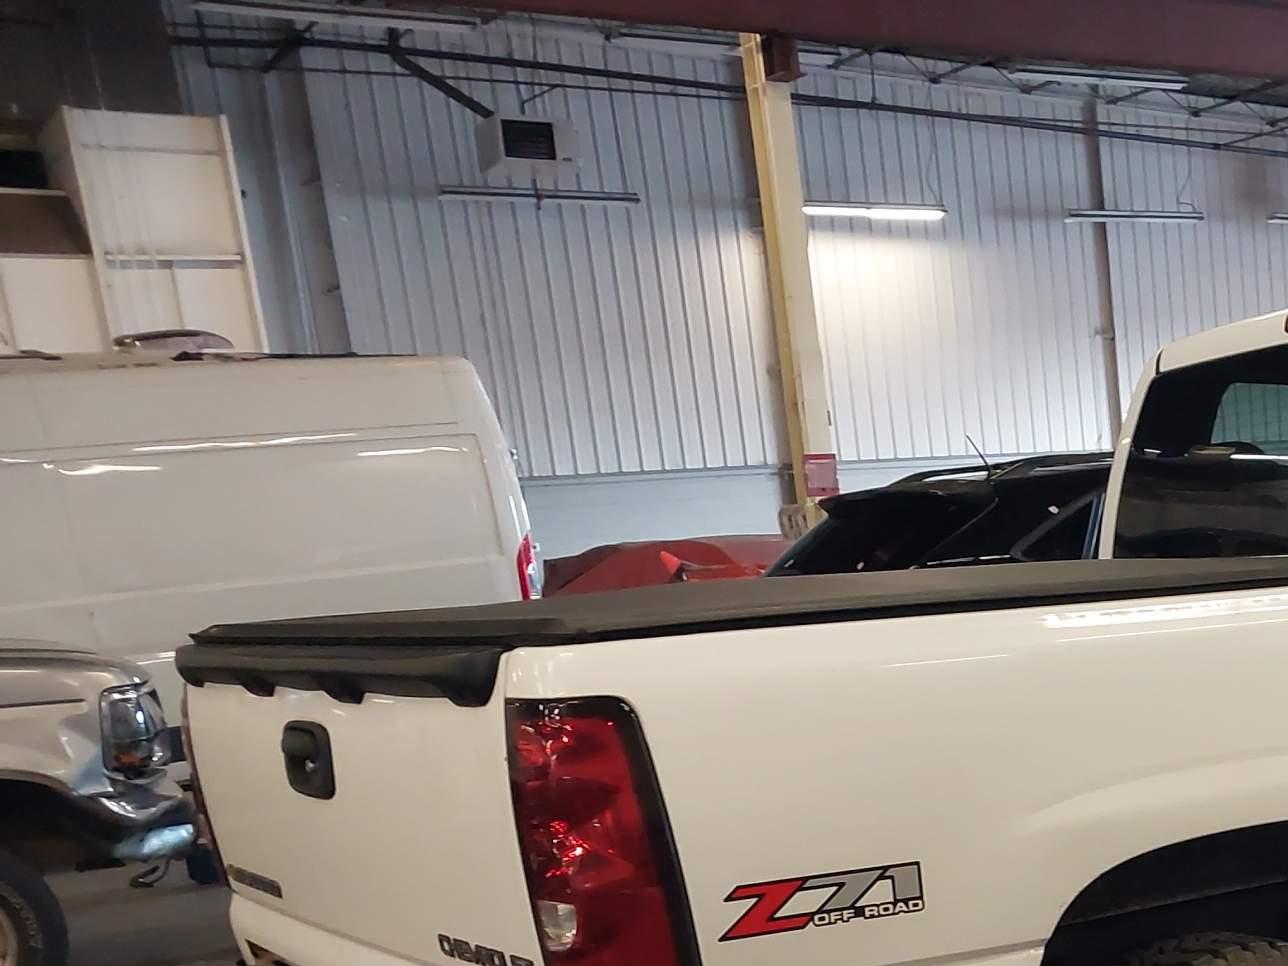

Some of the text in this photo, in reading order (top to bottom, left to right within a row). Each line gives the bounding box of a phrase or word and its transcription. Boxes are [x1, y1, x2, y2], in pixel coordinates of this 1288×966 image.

[718, 861, 924, 942] Z71
[813, 899, 924, 926] OFF ROAD
